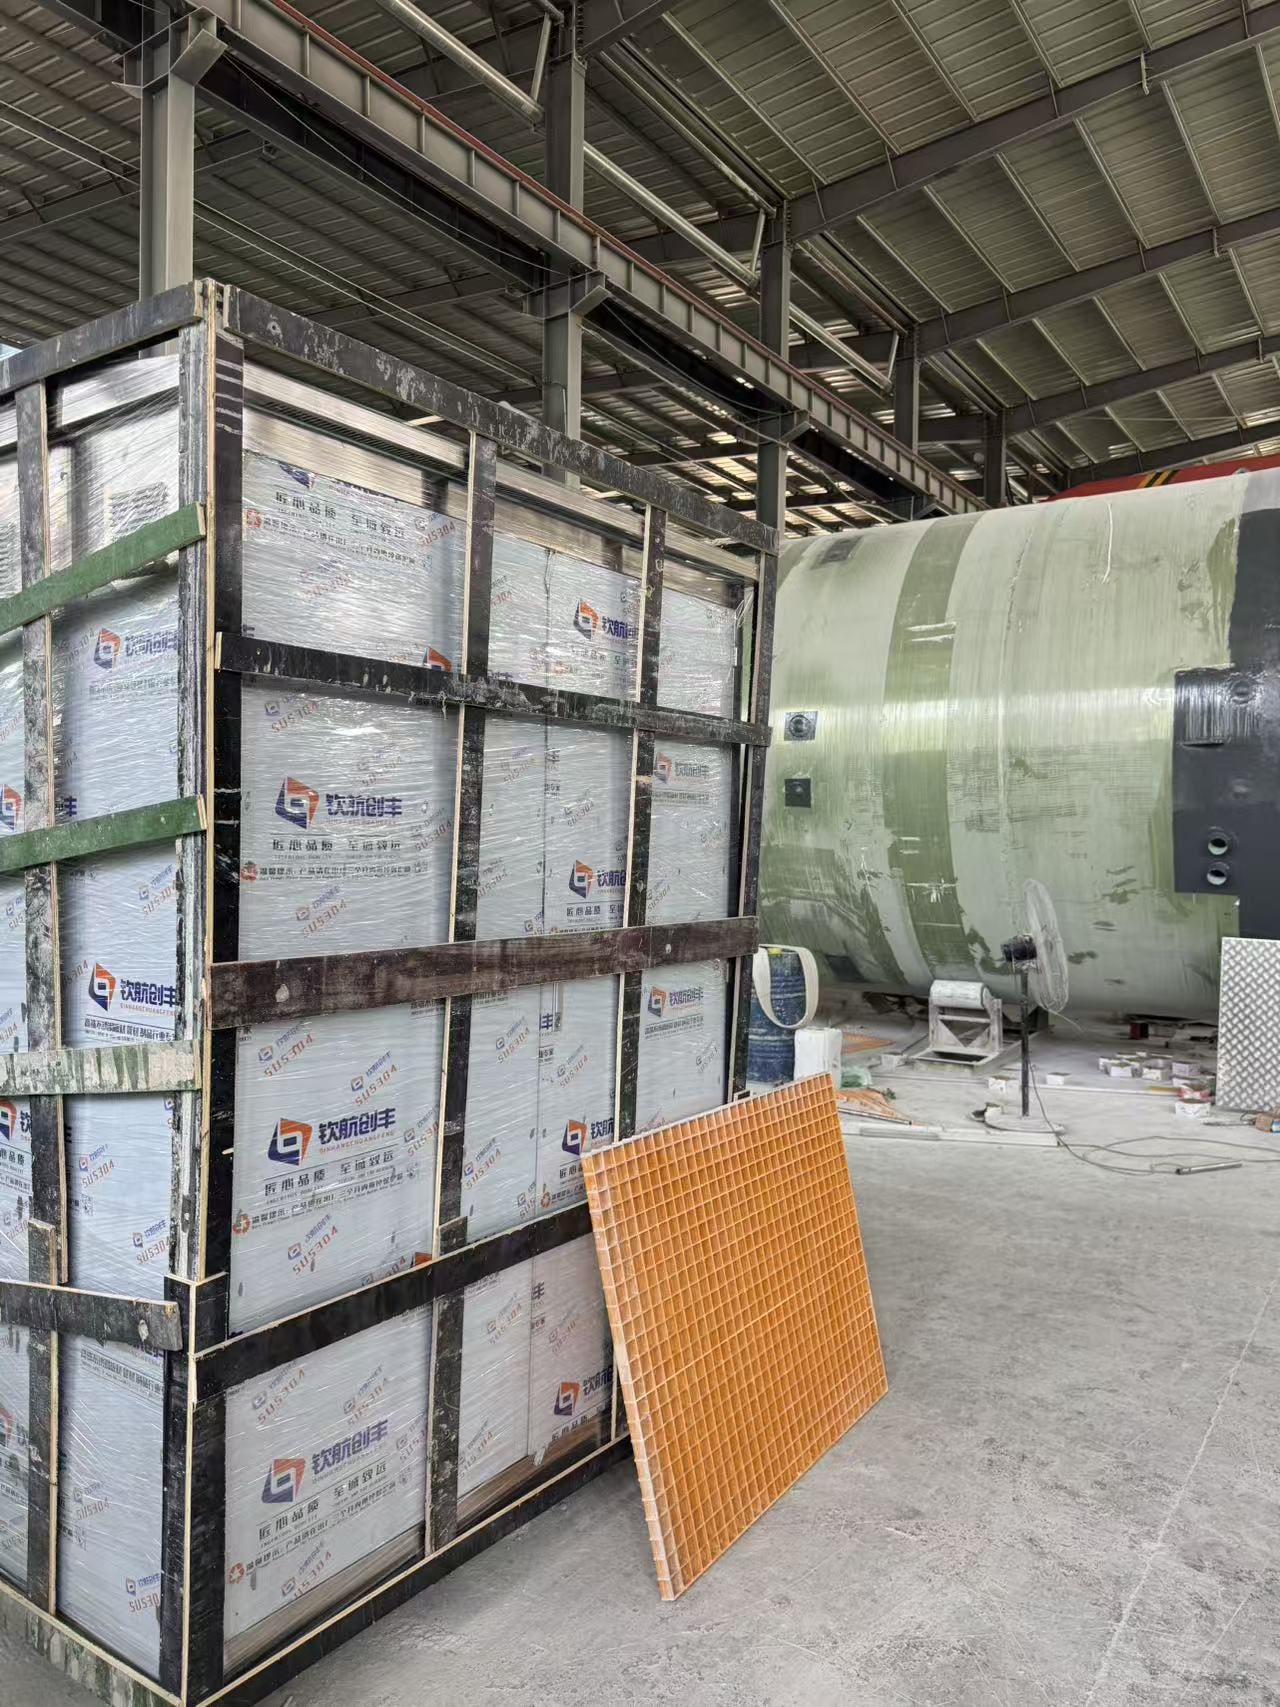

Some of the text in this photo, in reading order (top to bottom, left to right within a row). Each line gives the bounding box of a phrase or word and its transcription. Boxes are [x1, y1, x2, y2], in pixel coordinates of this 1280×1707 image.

[325, 793, 403, 818] 钦航创丰
[120, 979, 180, 1007] 钦航创丰
[355, 1064, 398, 1105] SUS304
[318, 1107, 396, 1145] 钦航创丰
[82, 1159, 115, 1189] SUS304
[264, 1168, 326, 1197] 匠心品质
[292, 1224, 338, 1276] SUS304
[311, 1418, 389, 1475] 钦航创丰
